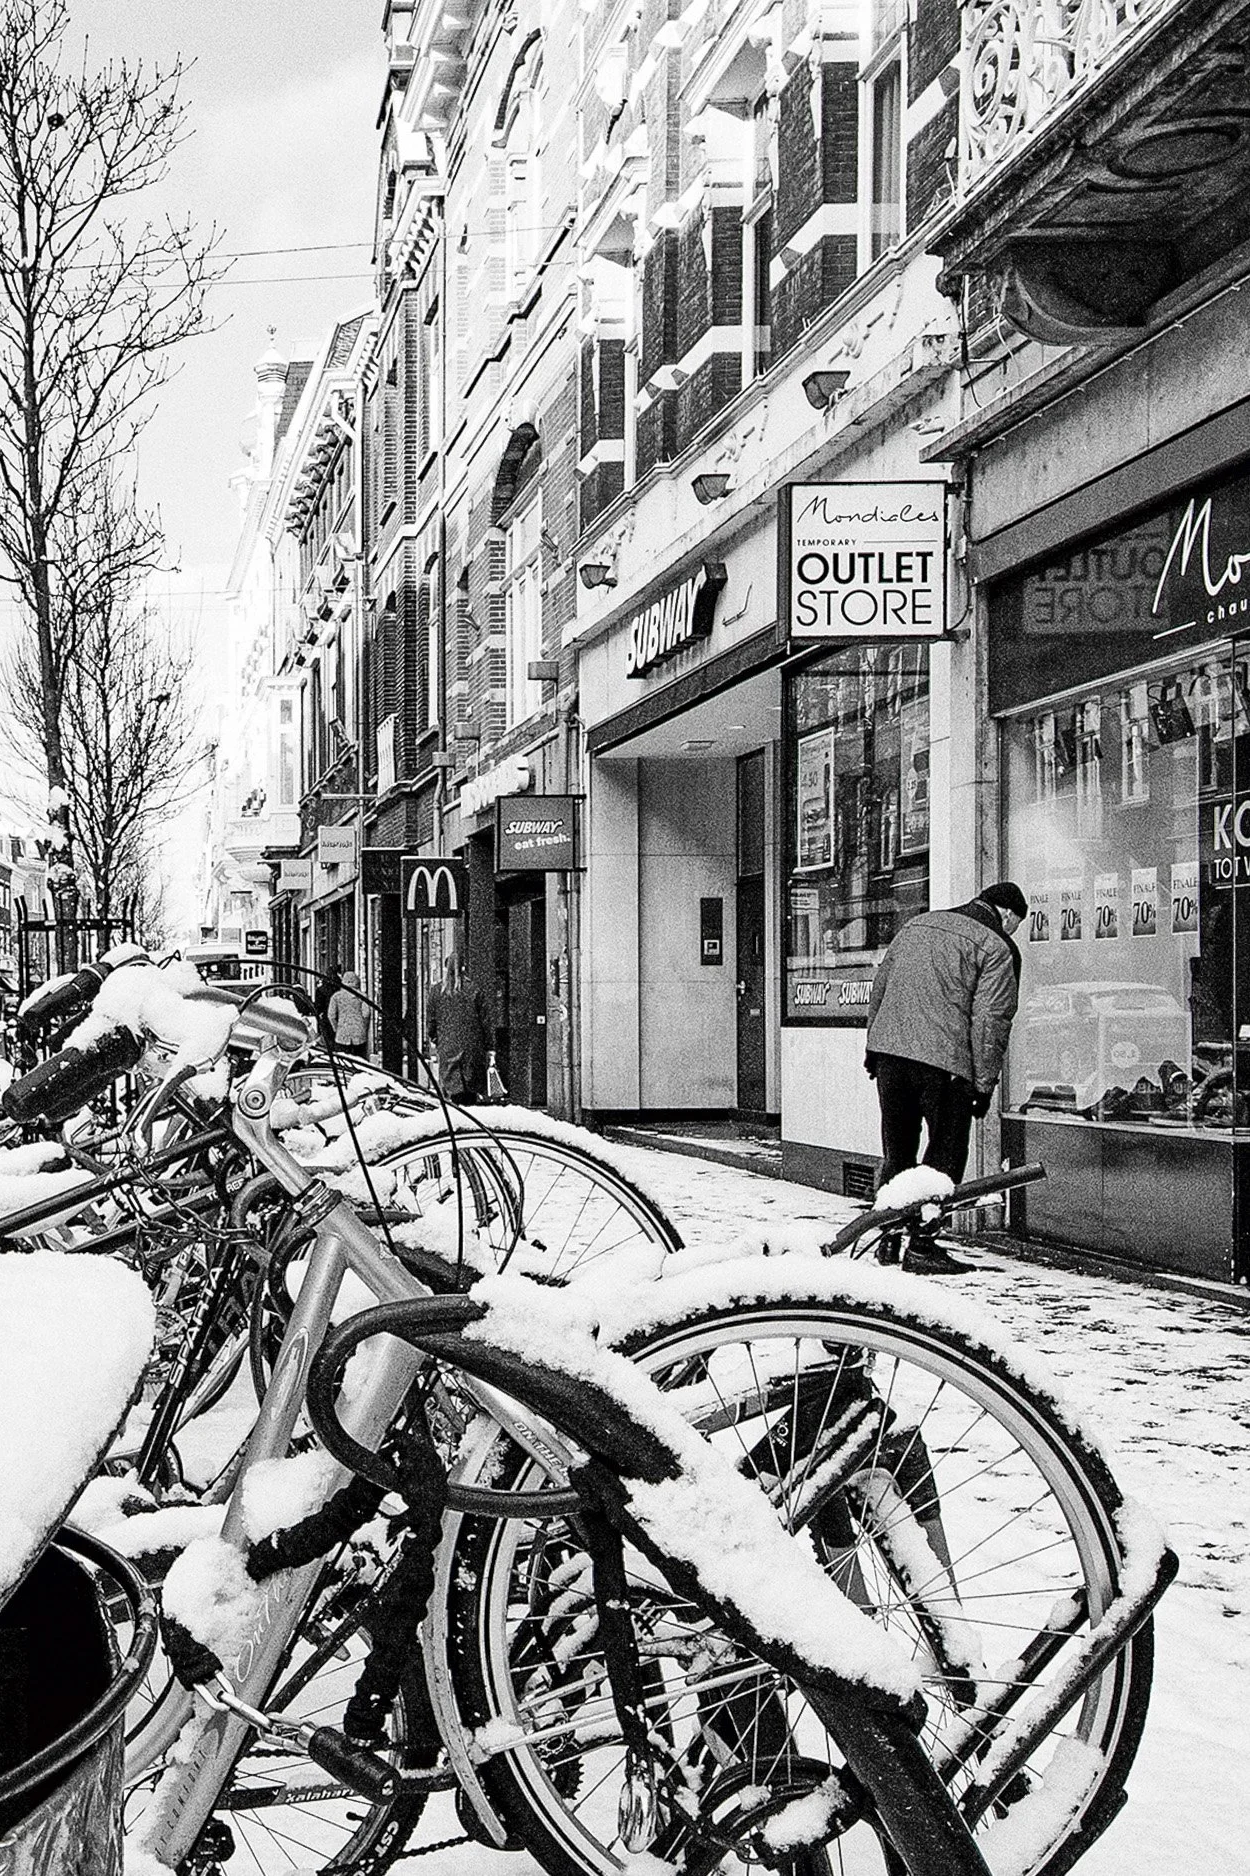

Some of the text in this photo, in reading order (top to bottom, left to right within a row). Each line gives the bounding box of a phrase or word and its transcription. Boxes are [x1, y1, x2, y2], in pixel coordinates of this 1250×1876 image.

[797, 495, 939, 524] Mondiales
[797, 538, 857, 547] TEMPORARY
[797, 551, 934, 585] OUTLET
[627, 564, 707, 676] SUBWAY
[796, 589, 932, 627] STORE
[1207, 598, 1248, 624] chau
[504, 819, 564, 835] SUBWAY
[514, 838, 535, 850] eat
[1096, 887, 1117, 899] FINALE
[1133, 883, 1156, 894] FINALE
[1173, 876, 1198, 890] FINALE
[1061, 890, 1081, 901] FINALE
[1061, 908, 1082, 930] 70%
[1096, 905, 1118, 929] 70%
[1133, 901, 1156, 925] 70%
[1173, 896, 1198, 922] 70%
[794, 982, 831, 1006] SUBWAY
[168, 1266, 225, 1389] SPARTA
[373, 1819, 400, 1859] CST
